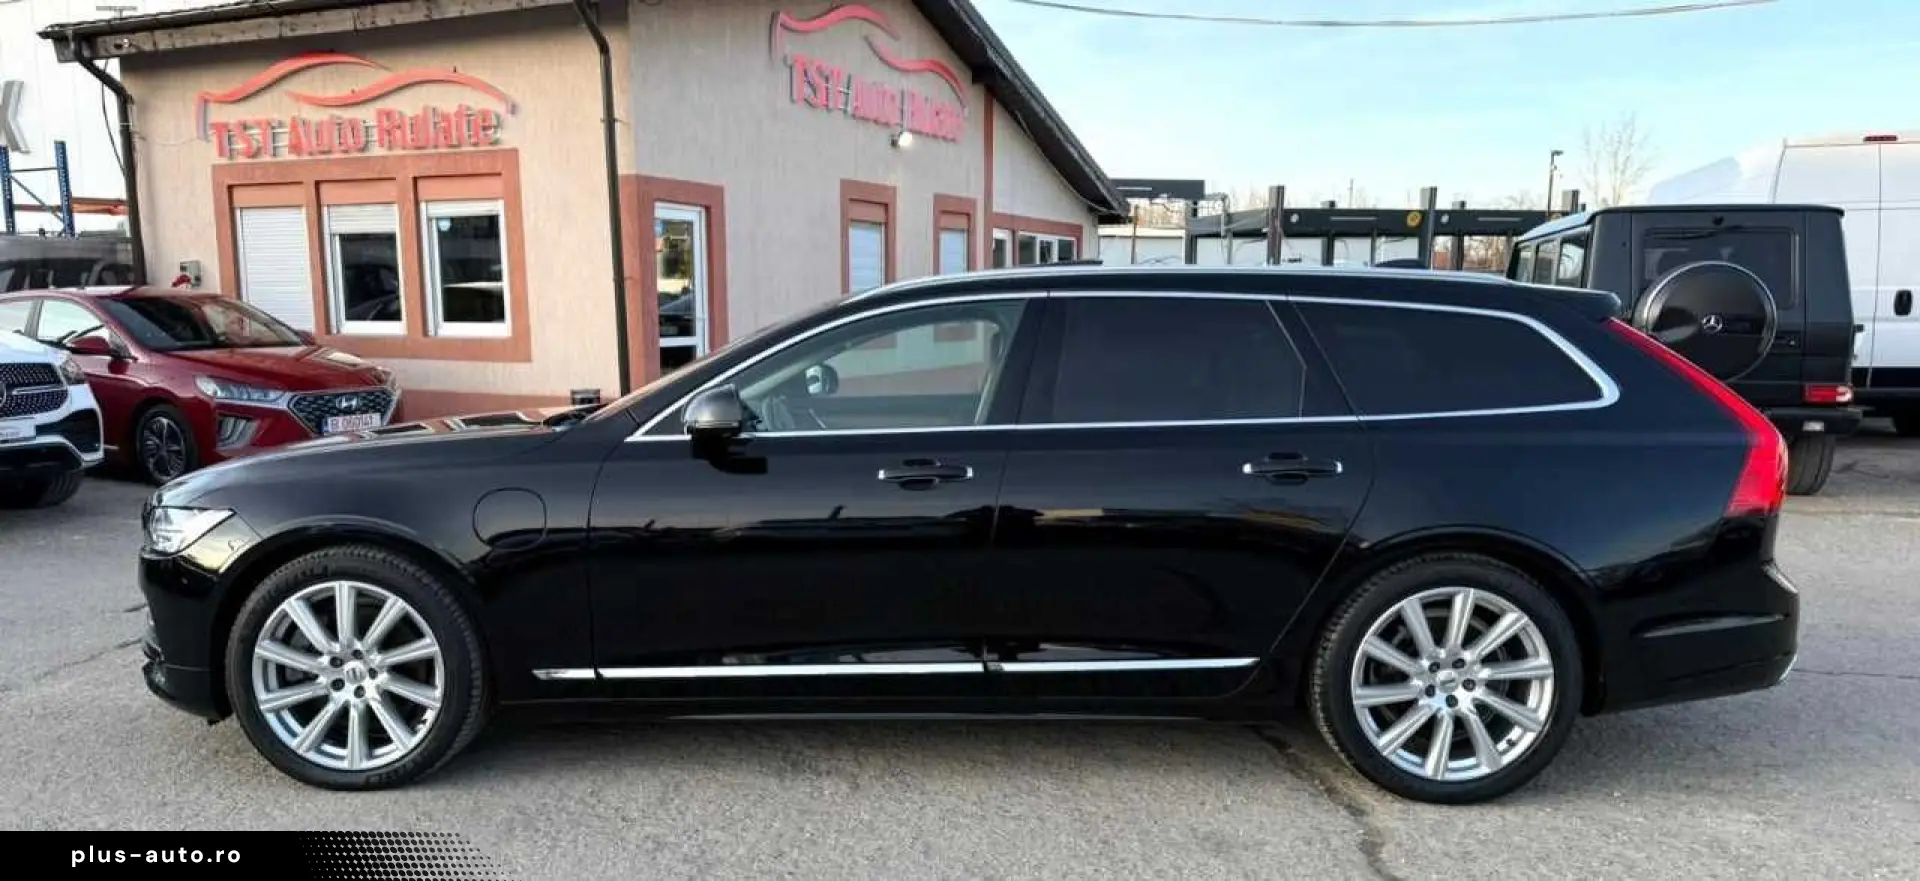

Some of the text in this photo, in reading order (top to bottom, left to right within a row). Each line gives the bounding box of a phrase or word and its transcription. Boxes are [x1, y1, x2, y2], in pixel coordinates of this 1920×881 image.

[788, 54, 846, 113] TST
[208, 103, 500, 159] TST Auto Rulate
